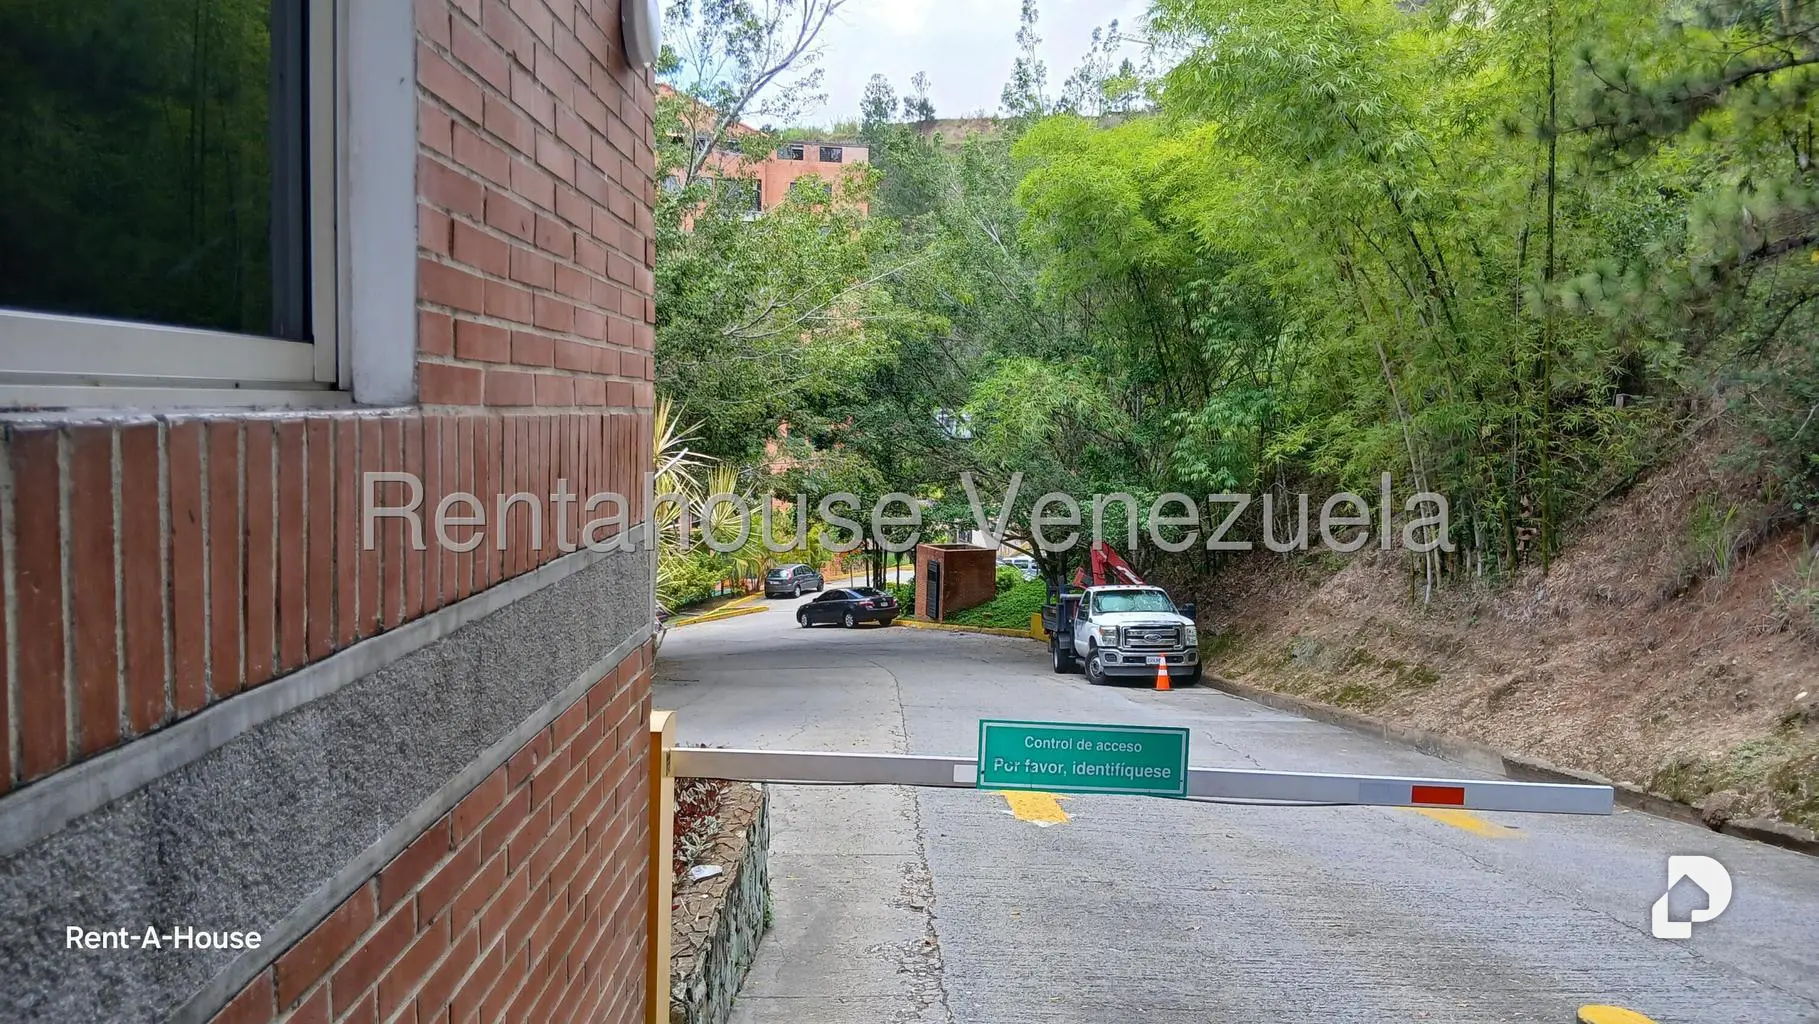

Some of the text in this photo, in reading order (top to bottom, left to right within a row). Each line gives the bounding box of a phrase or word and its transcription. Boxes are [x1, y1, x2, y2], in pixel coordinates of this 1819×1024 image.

[1024, 735, 1142, 753] Control de acceso
[993, 757, 1171, 780] Por favor, identifíquese
